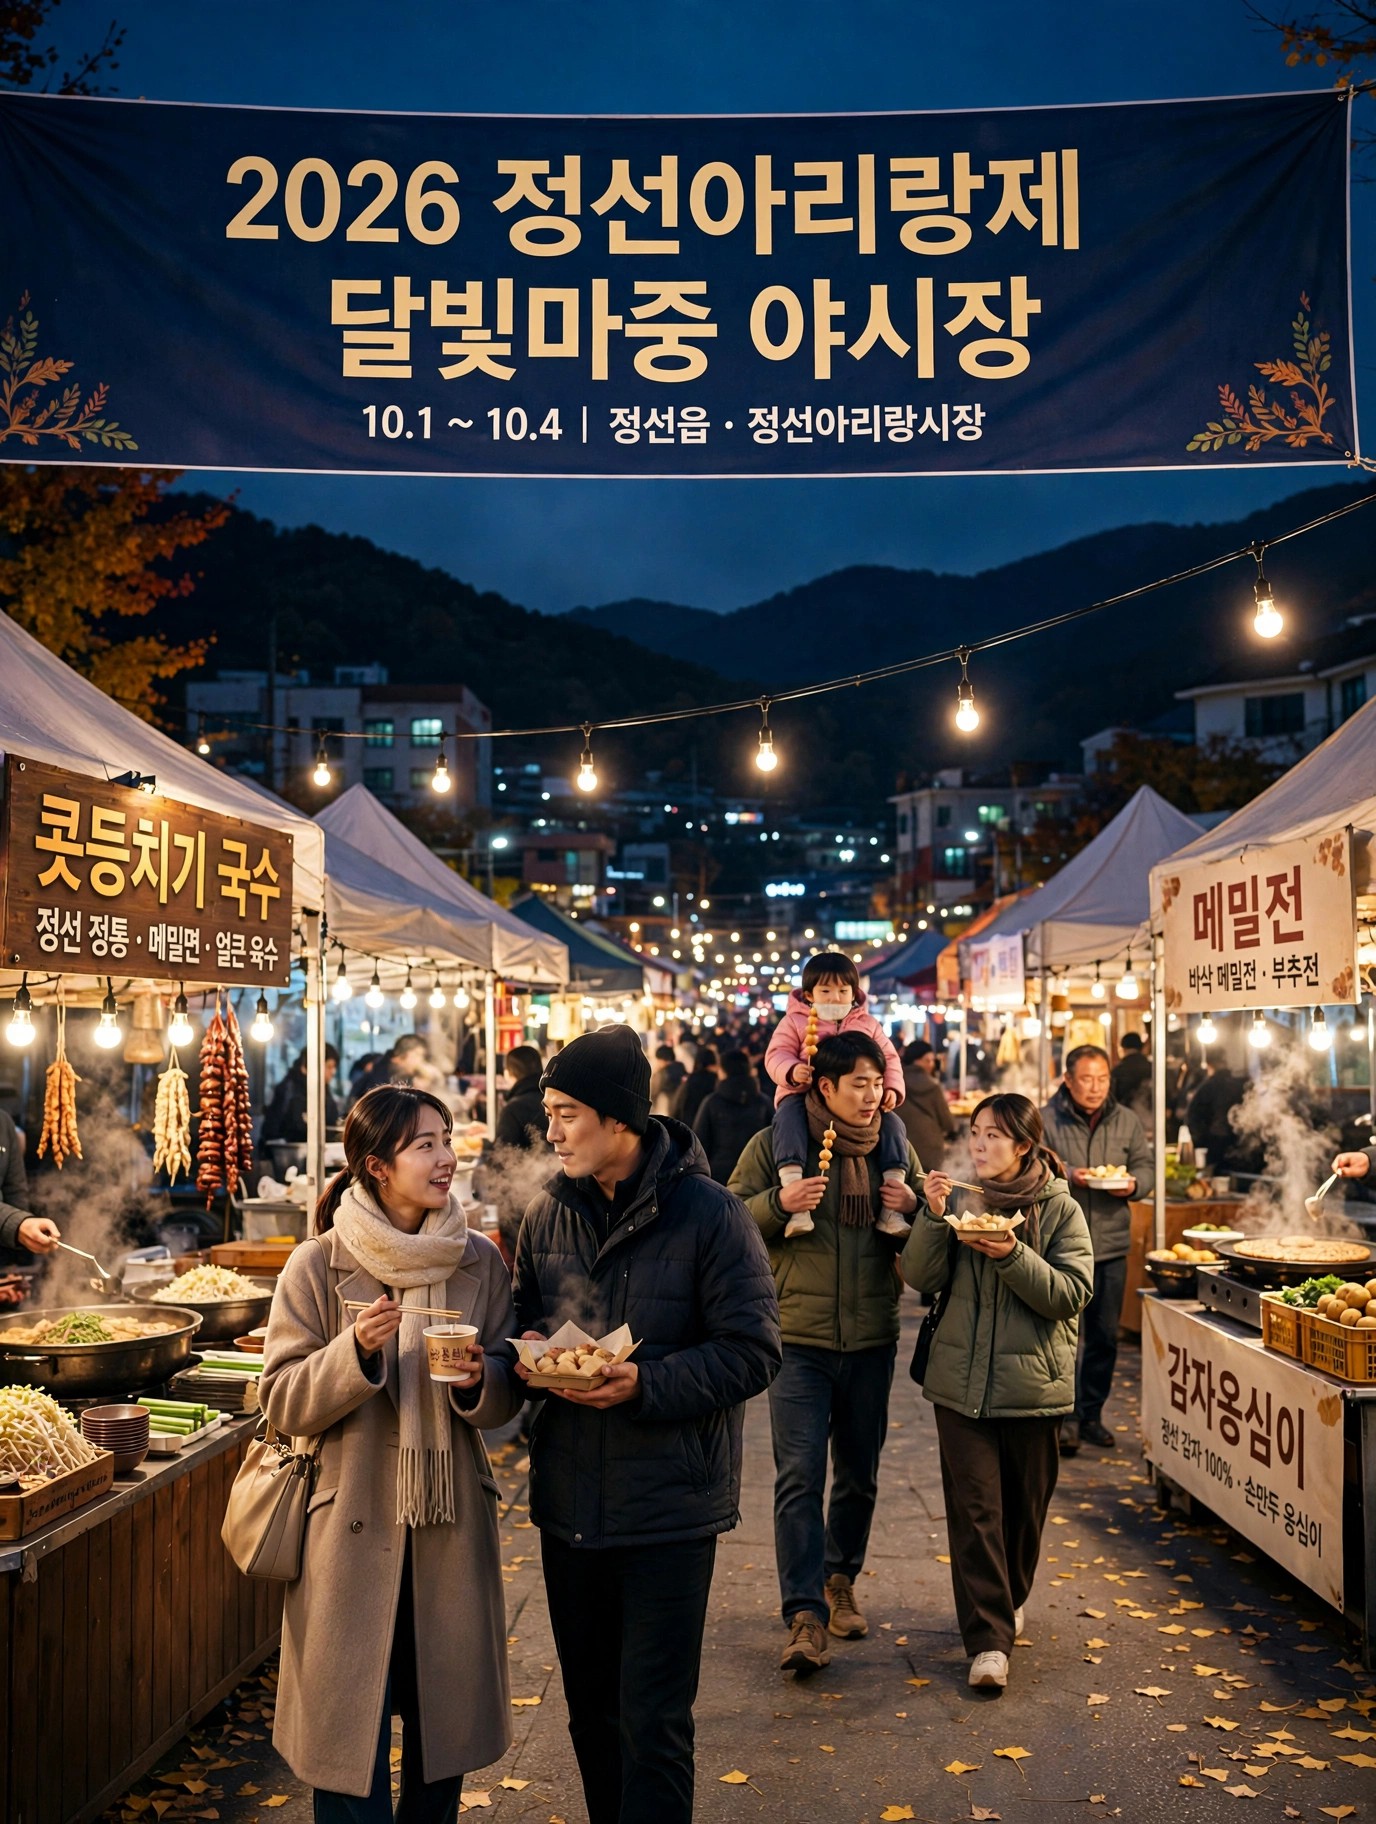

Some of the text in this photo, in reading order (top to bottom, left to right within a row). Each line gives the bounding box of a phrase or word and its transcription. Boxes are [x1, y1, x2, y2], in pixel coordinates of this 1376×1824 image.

[226, 148, 1080, 257] 2026 정선아리랑제
[331, 276, 1042, 383] 달빛마중 야시장
[362, 404, 432, 440] 10.1
[486, 406, 563, 441] 10.4
[609, 404, 712, 445] 정선읍
[747, 402, 986, 444] 정선아리랑시장
[35, 793, 281, 921] 콧등치기 국수
[1193, 865, 1304, 952] 메밀전
[36, 907, 82, 954] 정선
[88, 914, 130, 958] 정통
[148, 923, 200, 964] 메밀면
[215, 931, 247, 969] 얼큰
[249, 935, 279, 972] 육수
[1189, 963, 1214, 995] 바삭
[1217, 958, 1257, 992] 메밀전
[1272, 952, 1320, 989] 부추전
[1161, 1416, 1179, 1453] 정선
[1181, 1430, 1203, 1469] 감자
[1205, 1448, 1233, 1489] 100%
[1244, 1475, 1280, 1524] 손만두
[1168, 1343, 1305, 1491] 감자옹심이
